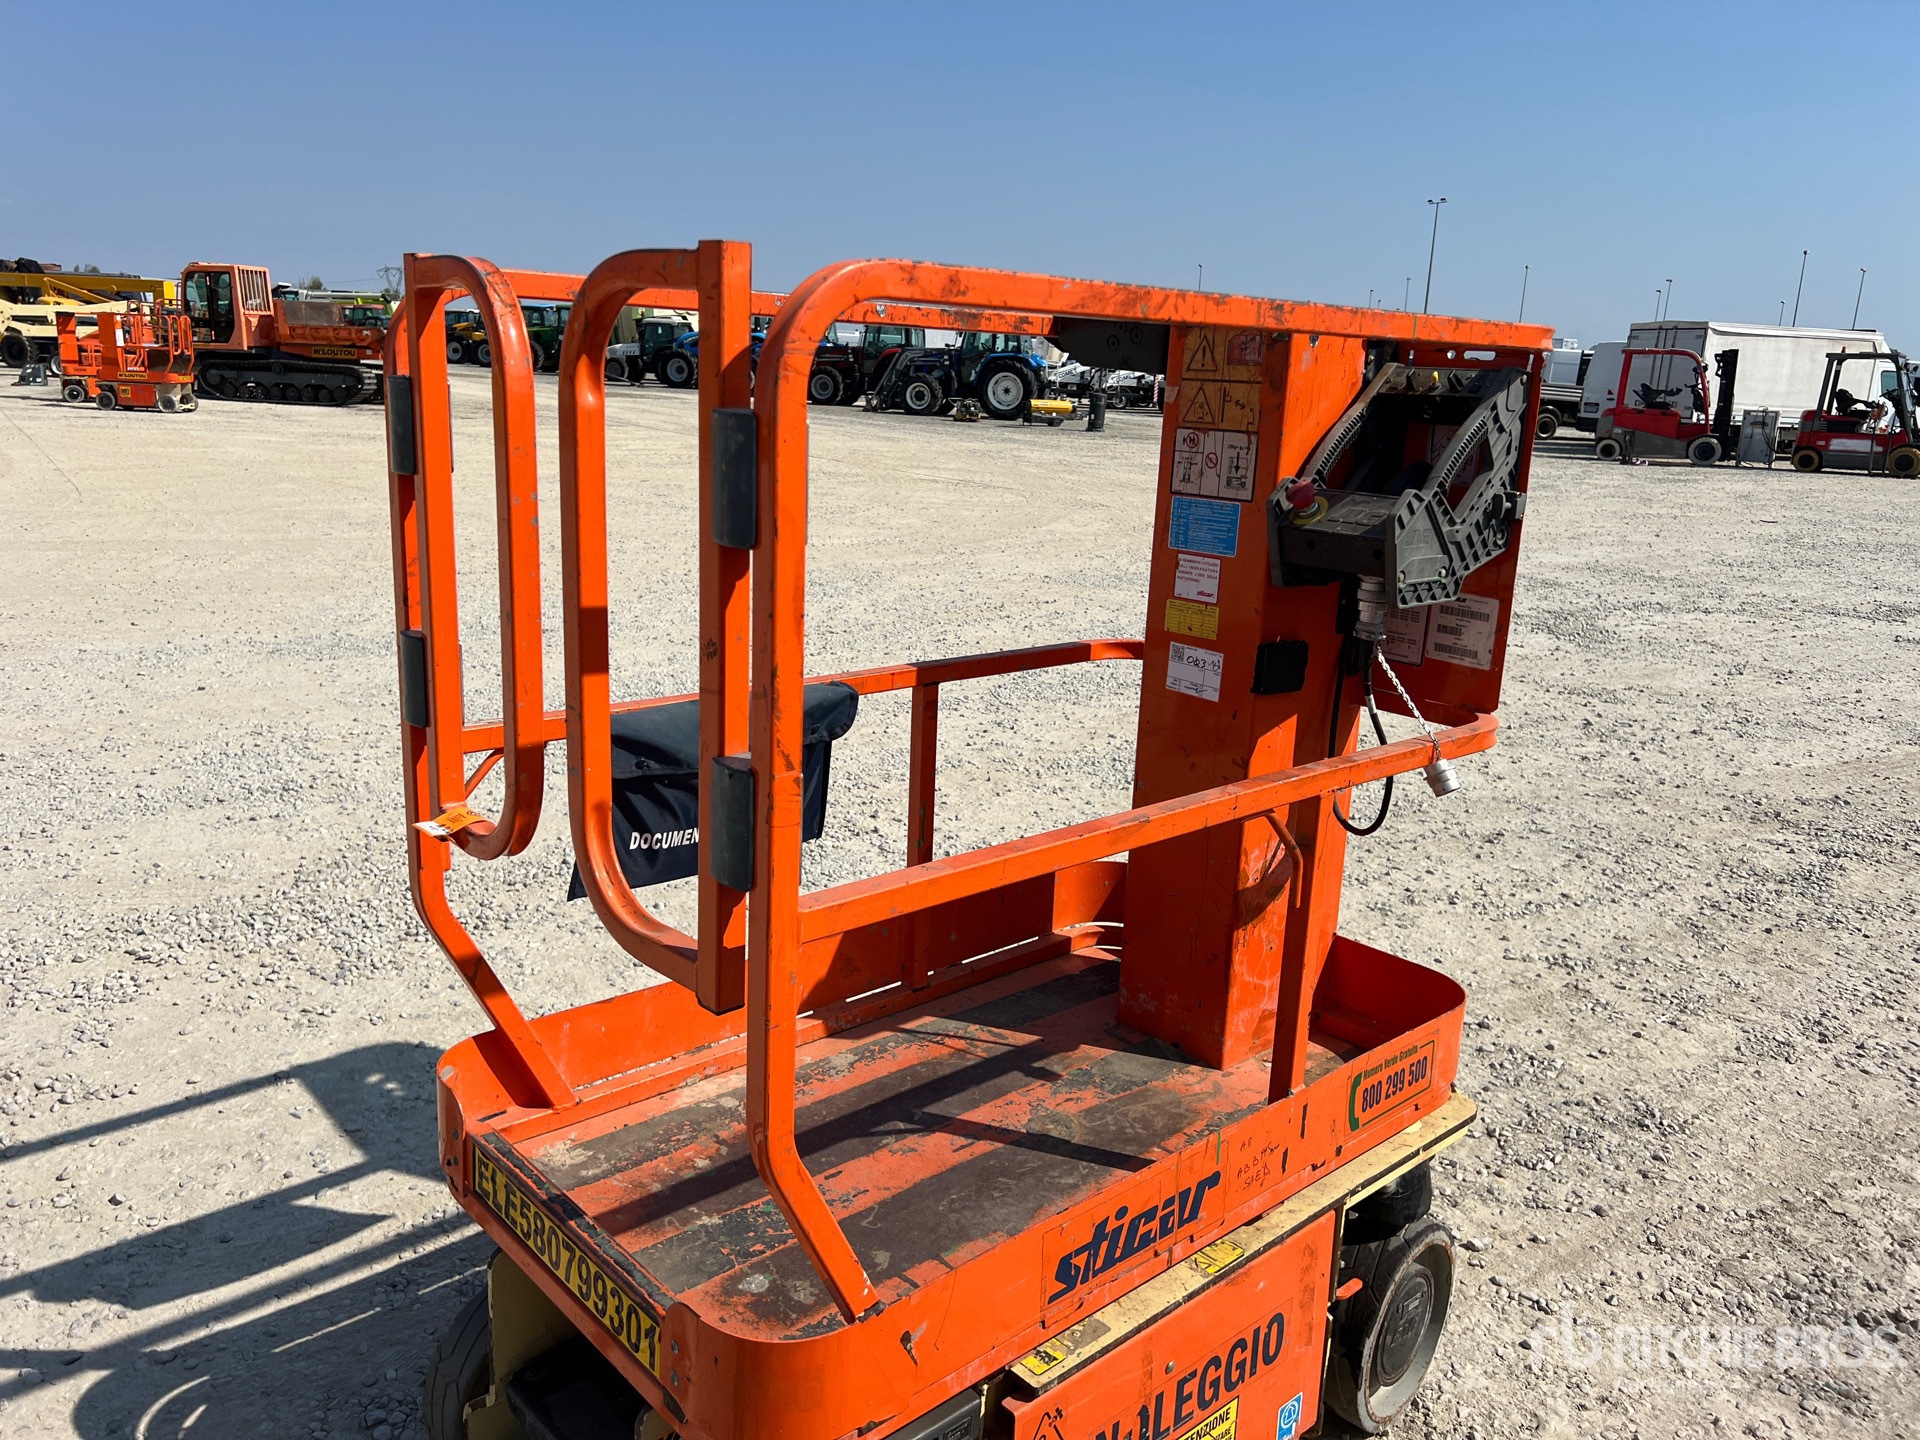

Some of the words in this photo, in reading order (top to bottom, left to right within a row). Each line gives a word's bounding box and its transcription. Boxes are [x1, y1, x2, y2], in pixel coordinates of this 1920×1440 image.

[1361, 1080, 1383, 1113] 800
[1385, 1067, 1406, 1101] 299
[1408, 1055, 1428, 1087] 500
[477, 1157, 657, 1374] ELE580799301
[1095, 1311, 1285, 1440] LEGGIO
